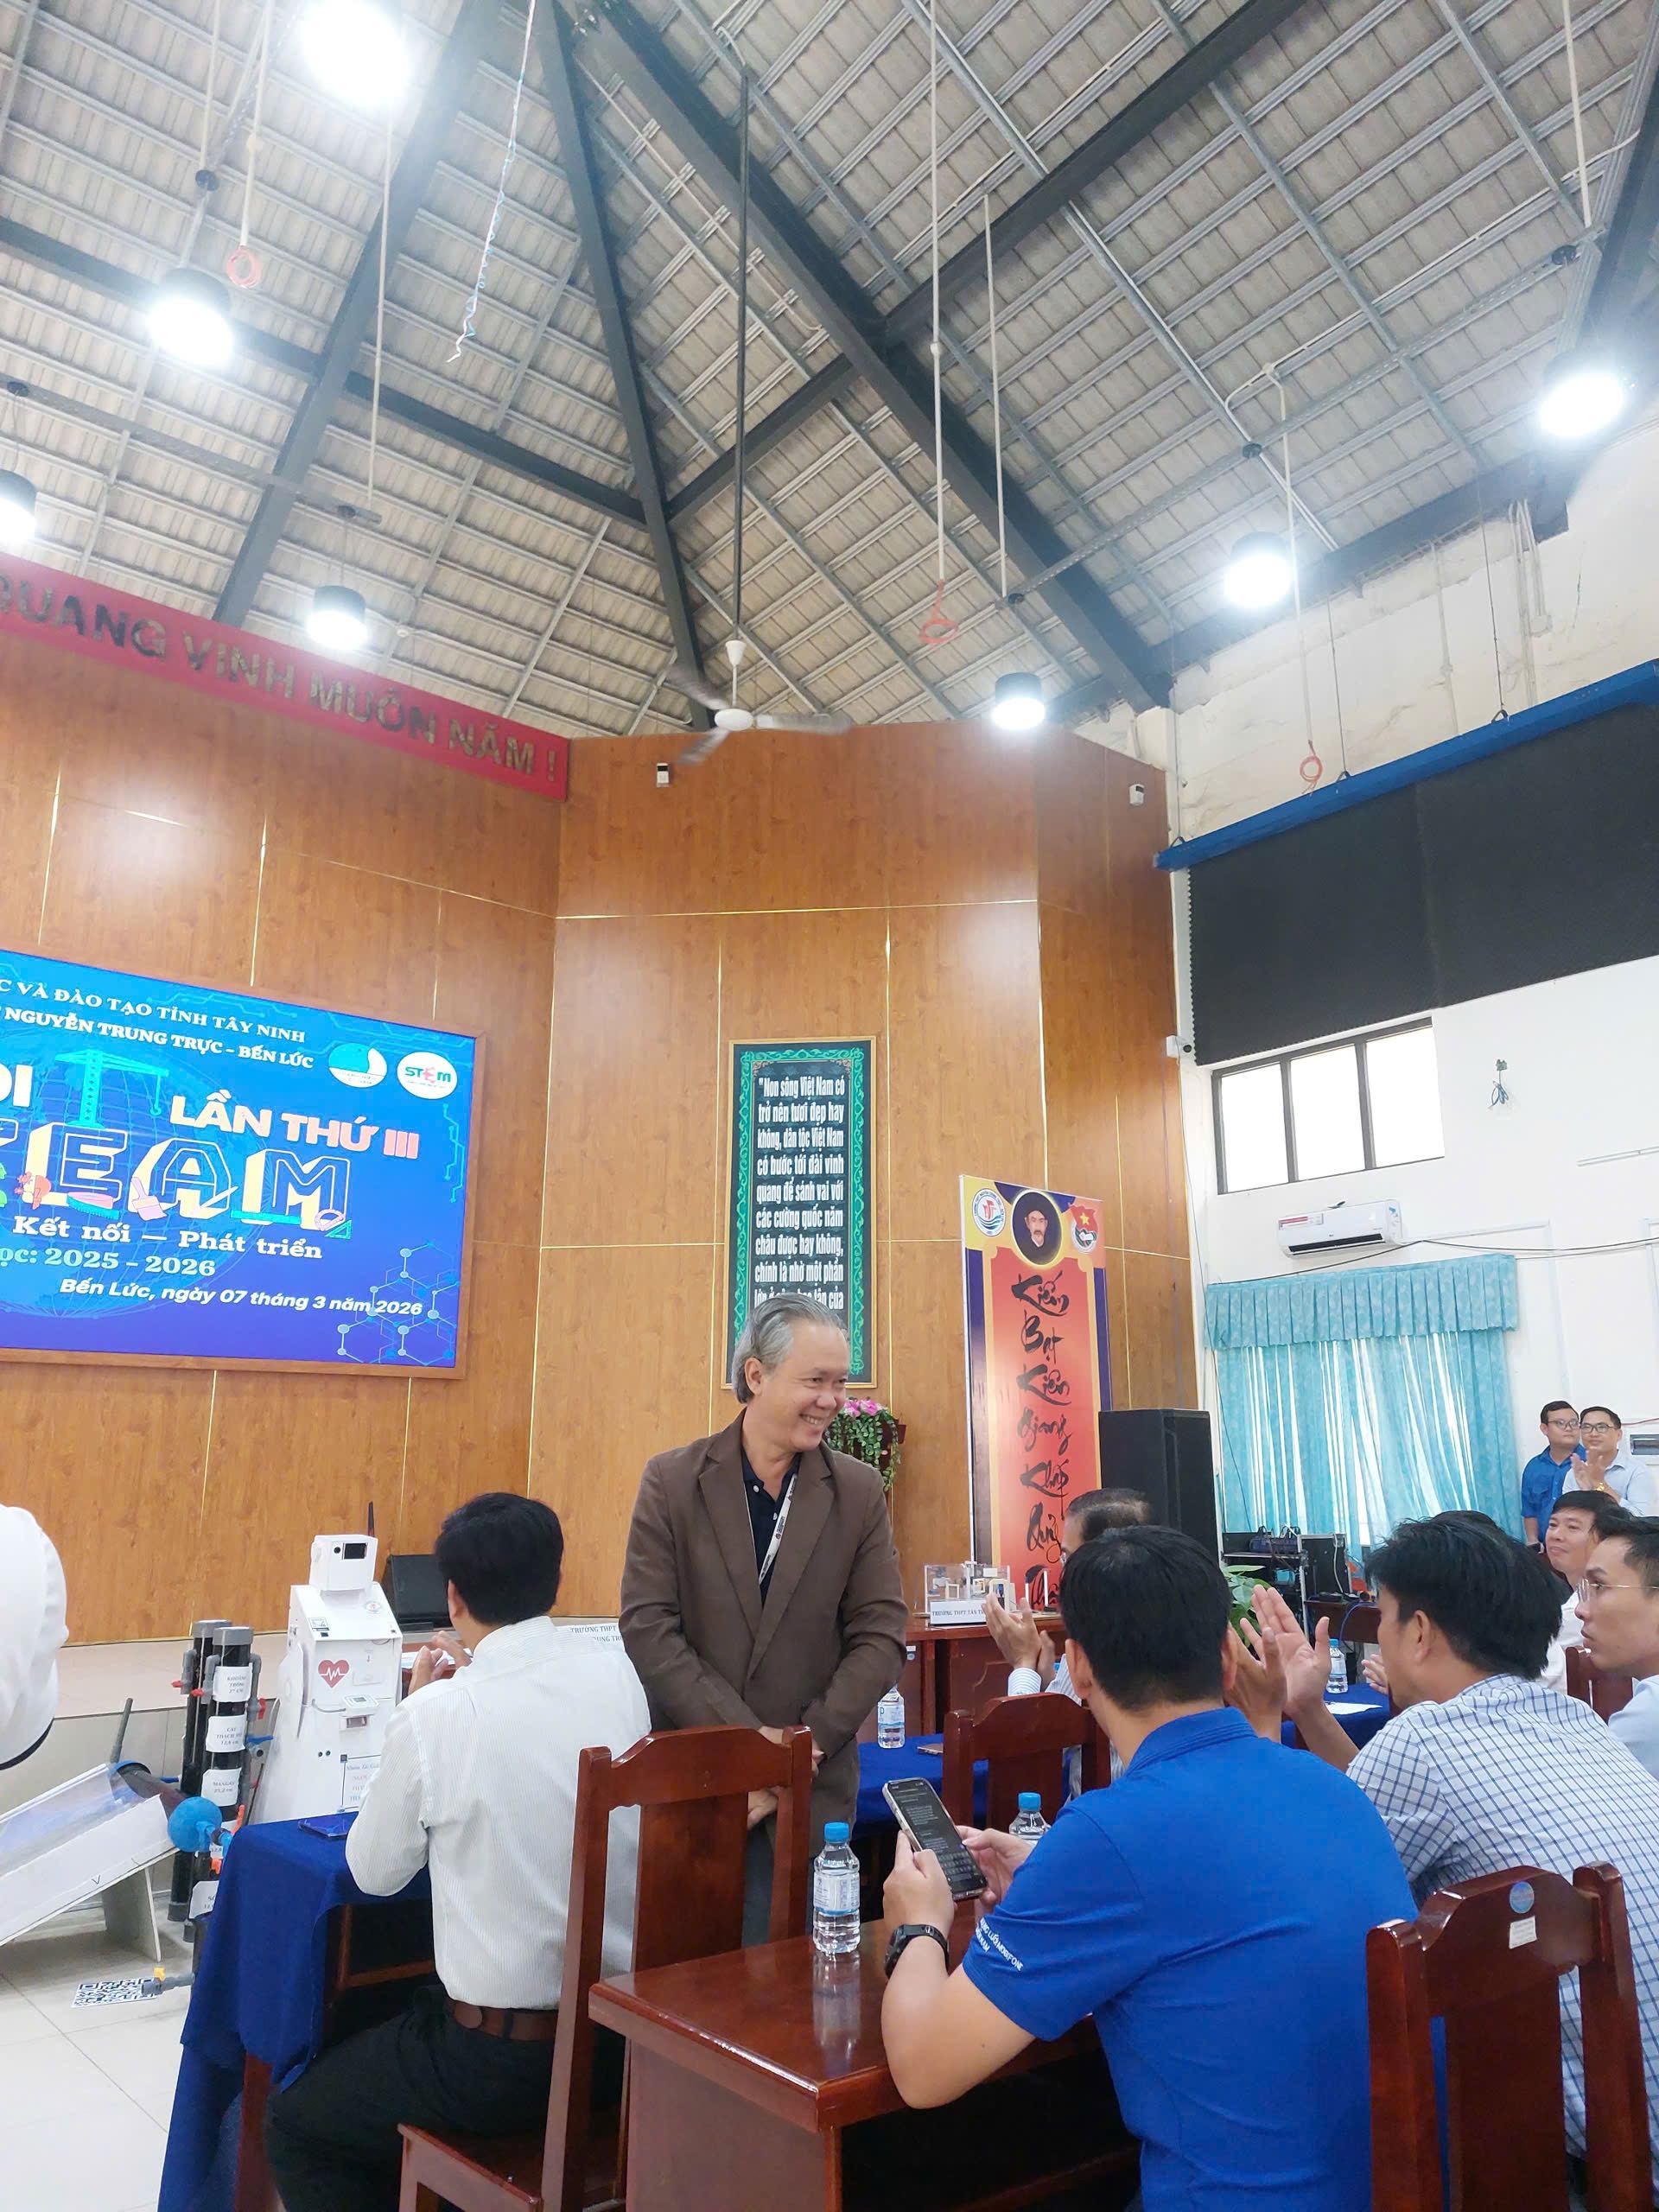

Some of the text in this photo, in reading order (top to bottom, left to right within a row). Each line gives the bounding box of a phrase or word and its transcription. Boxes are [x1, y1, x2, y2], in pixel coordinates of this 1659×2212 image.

[183, 631, 296, 698] VINH
[309, 670, 435, 745] MUÔN
[448, 719, 535, 774] NĂM
[17, 982, 48, 999] VÀ
[54, 988, 102, 1007] ĐÀO
[107, 997, 152, 1016] TẠO
[156, 1006, 207, 1027] TỈNH
[213, 1016, 253, 1033] TÂY
[257, 1025, 305, 1043] NINH
[4, 1007, 94, 1033] NGUYỄN
[98, 1022, 167, 1045] TRUNG
[171, 1034, 223, 1055] TRỰC
[238, 1045, 276, 1063] BẾN
[279, 1051, 314, 1068] LỨC
[780, 1077, 798, 1099] sông
[800, 1076, 815, 1100] Việt
[816, 1076, 834, 1096] Nam
[835, 1075, 845, 1096] có
[170, 1089, 420, 1160] LẦN THỨ III
[758, 1100, 844, 1126] trở nên tươi đẹp hay
[757, 1127, 844, 1153] không, dân tộc Việt Nam
[757, 1154, 844, 1176] có bước tới đài vinh
[757, 1176, 843, 1205] quang để sánh vai với
[756, 1203, 843, 1230] các cường quốc năm
[12, 1216, 71, 1237] Kết
[81, 1222, 131, 1243] nối
[179, 1230, 246, 1253] Phát
[257, 1238, 322, 1259] triển
[755, 1232, 844, 1260] châu được hay không,
[44, 1248, 119, 1269] 2025
[144, 1255, 216, 1277] 2026
[754, 1257, 844, 1286] chính là nhờ một phần
[60, 1277, 423, 1315] Bến Lức, ngày 07 tháng 3 năm 2026
[829, 1285, 844, 1310] của
